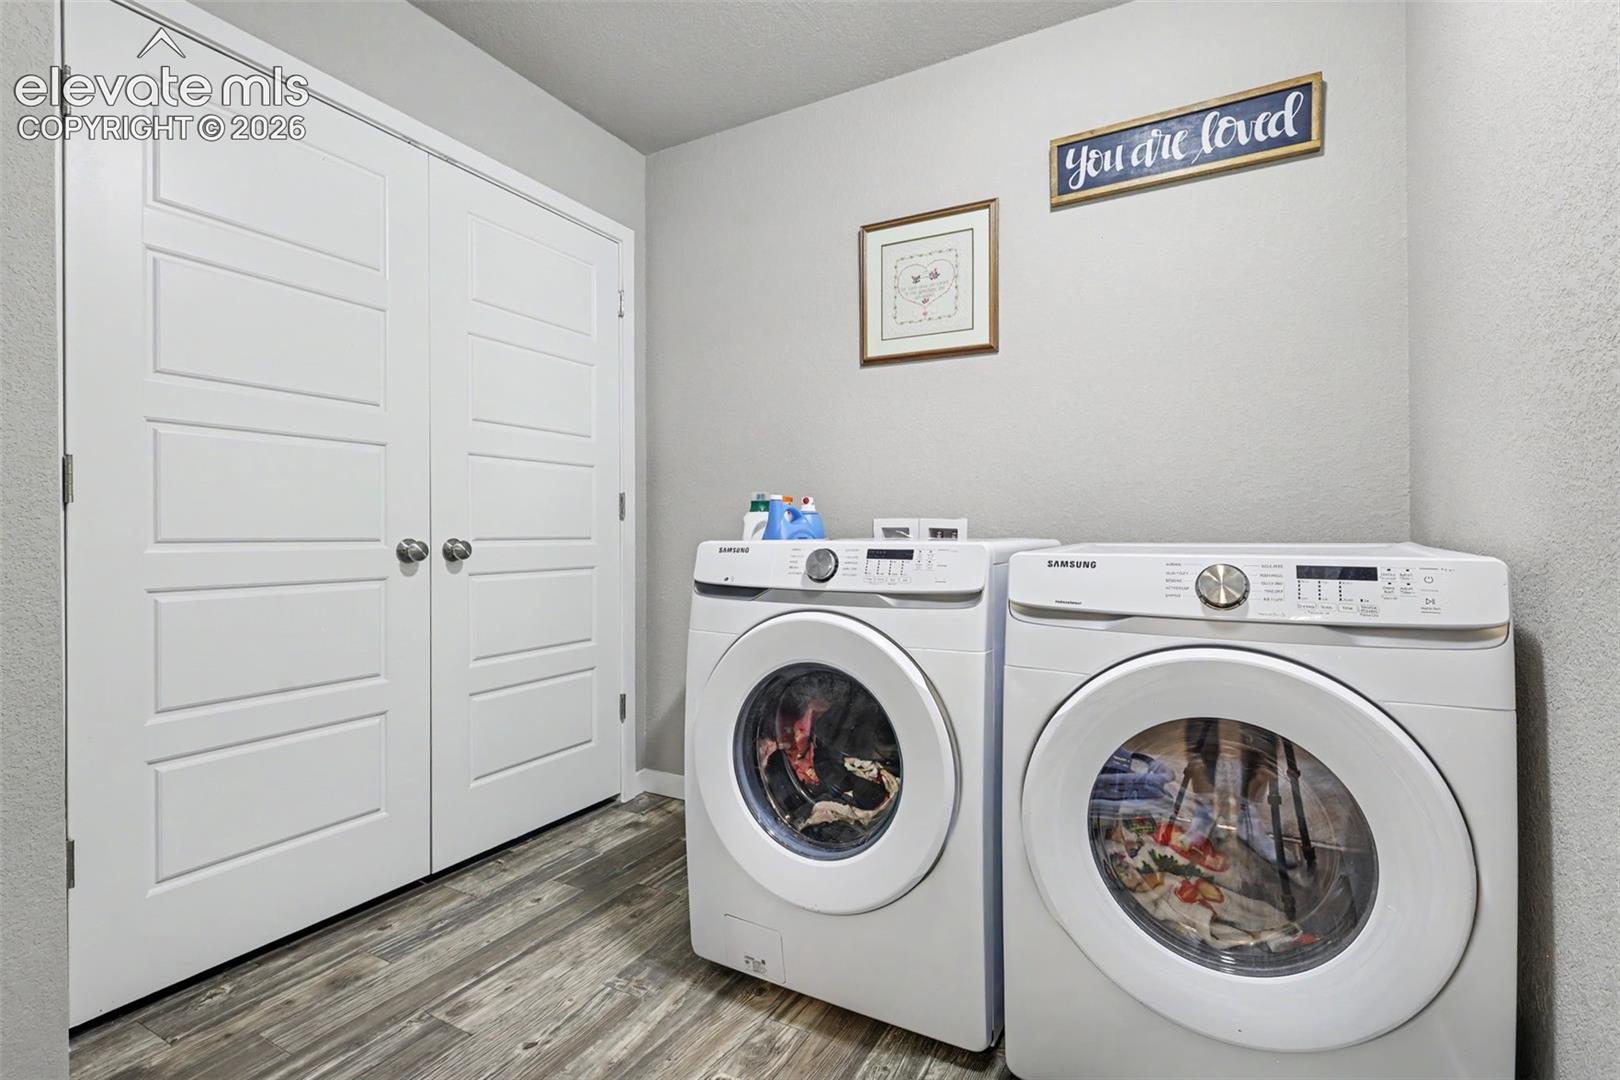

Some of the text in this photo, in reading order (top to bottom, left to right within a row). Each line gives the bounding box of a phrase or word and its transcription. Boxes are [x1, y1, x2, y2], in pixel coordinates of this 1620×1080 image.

[1131, 128, 1189, 169] are
[1191, 91, 1304, 164] loved
[1047, 560, 1097, 569] SAMSUNG
